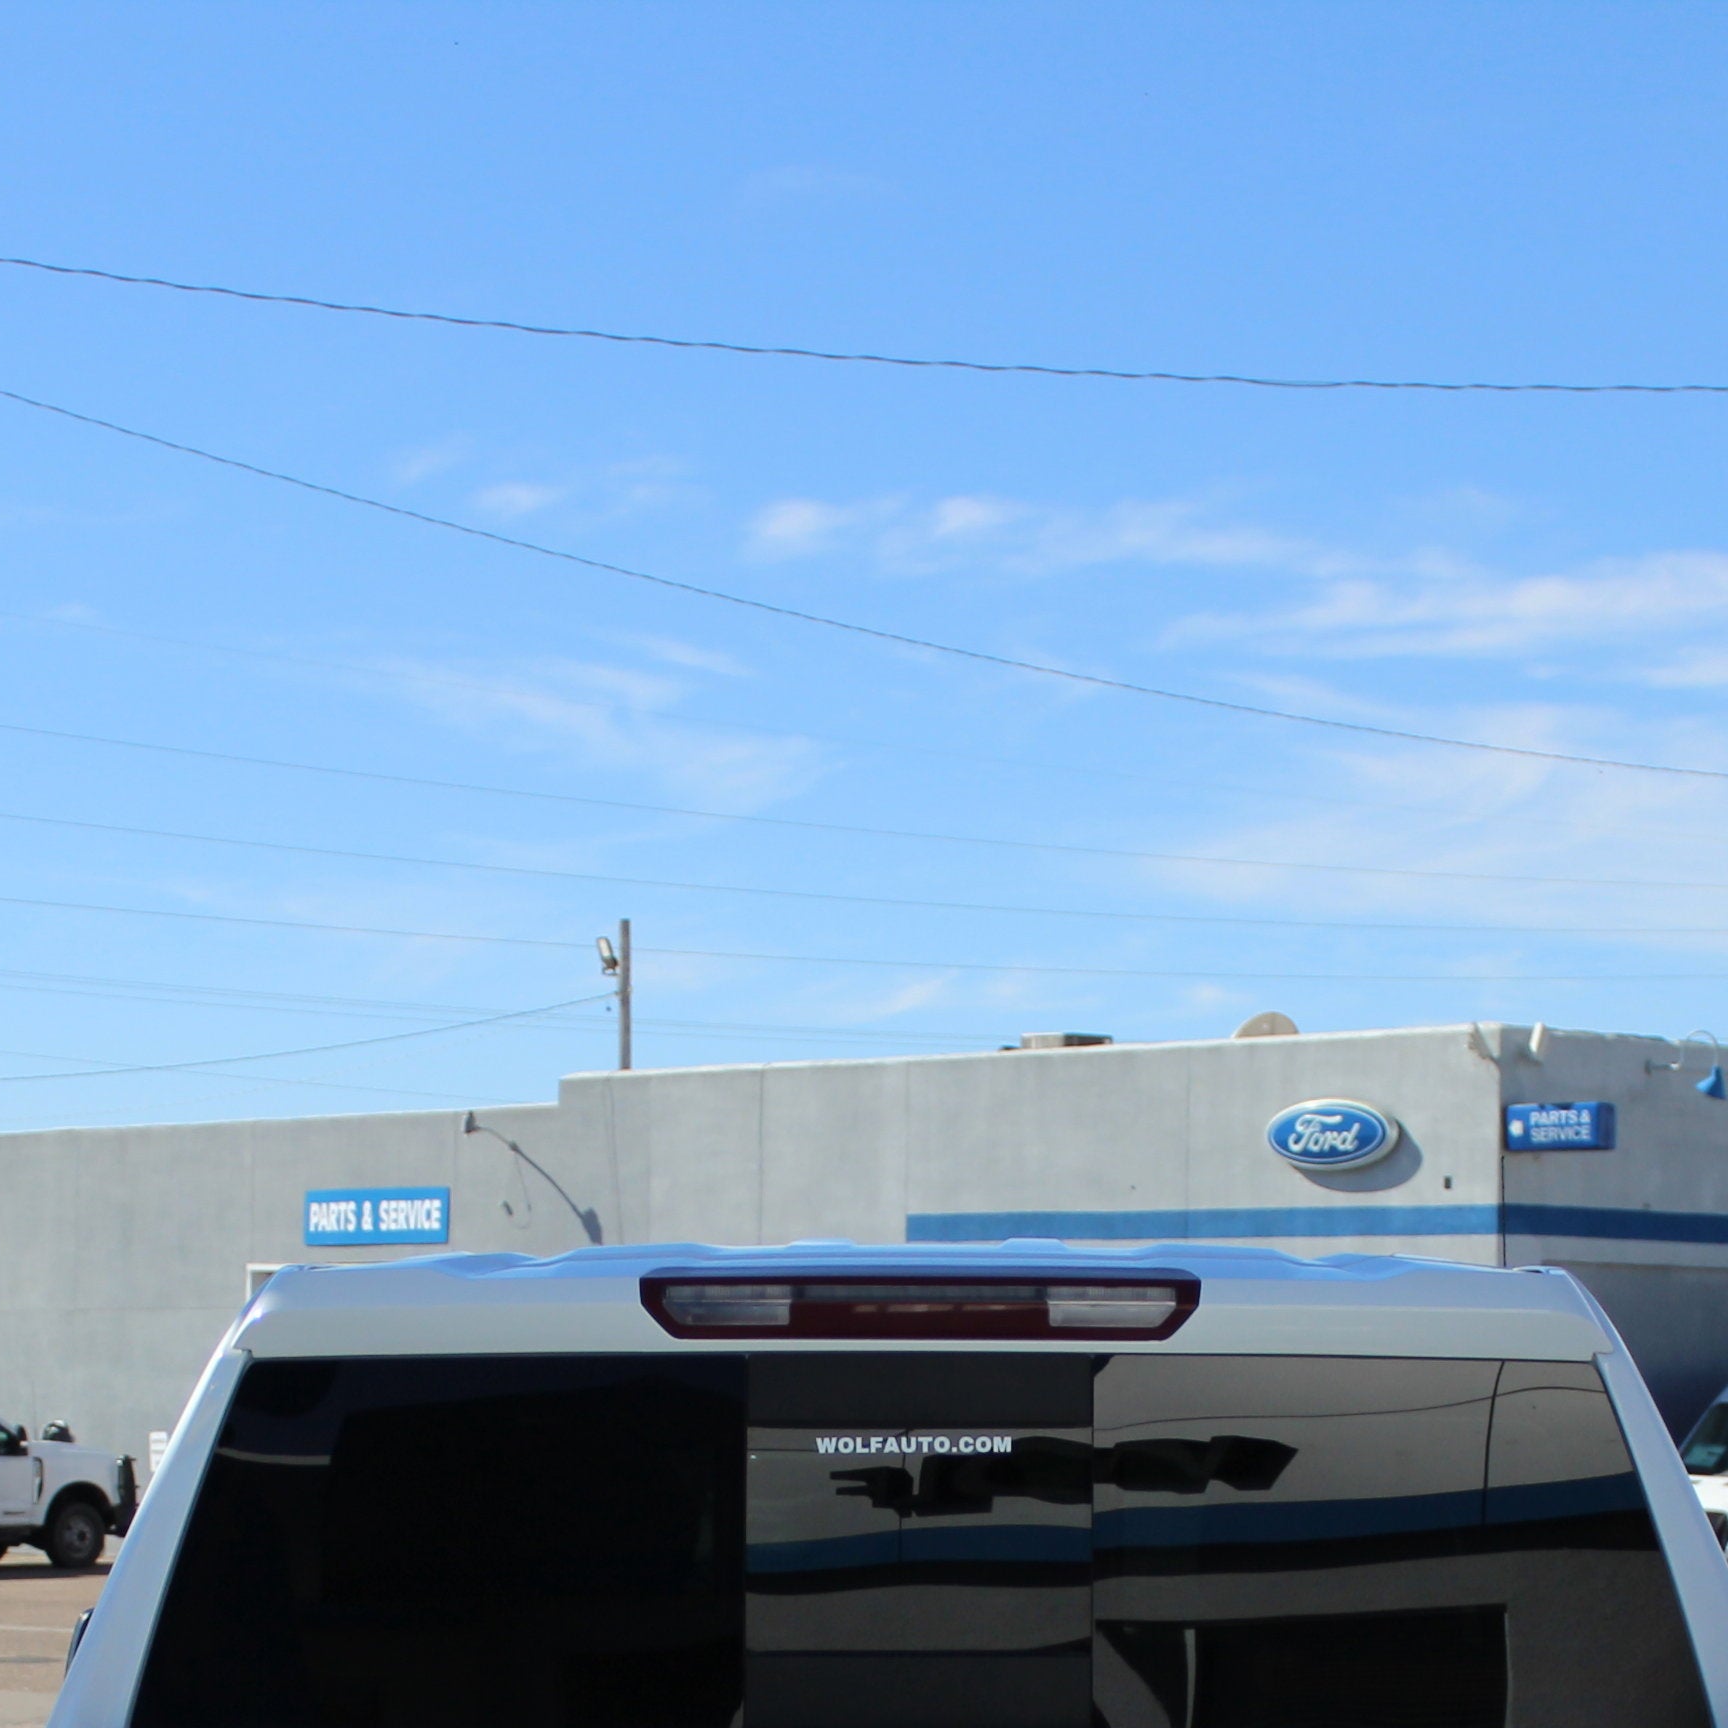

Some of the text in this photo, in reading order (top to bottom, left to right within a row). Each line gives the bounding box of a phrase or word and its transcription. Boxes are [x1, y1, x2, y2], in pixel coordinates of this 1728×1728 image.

[1529, 1109, 1591, 1126] PARTS &
[1287, 1114, 1361, 1152] Ford
[1531, 1124, 1591, 1143] SERVICE
[309, 1199, 442, 1232] PARTS & SERVICE
[815, 1436, 1012, 1454] WOLFAUTO.COM
